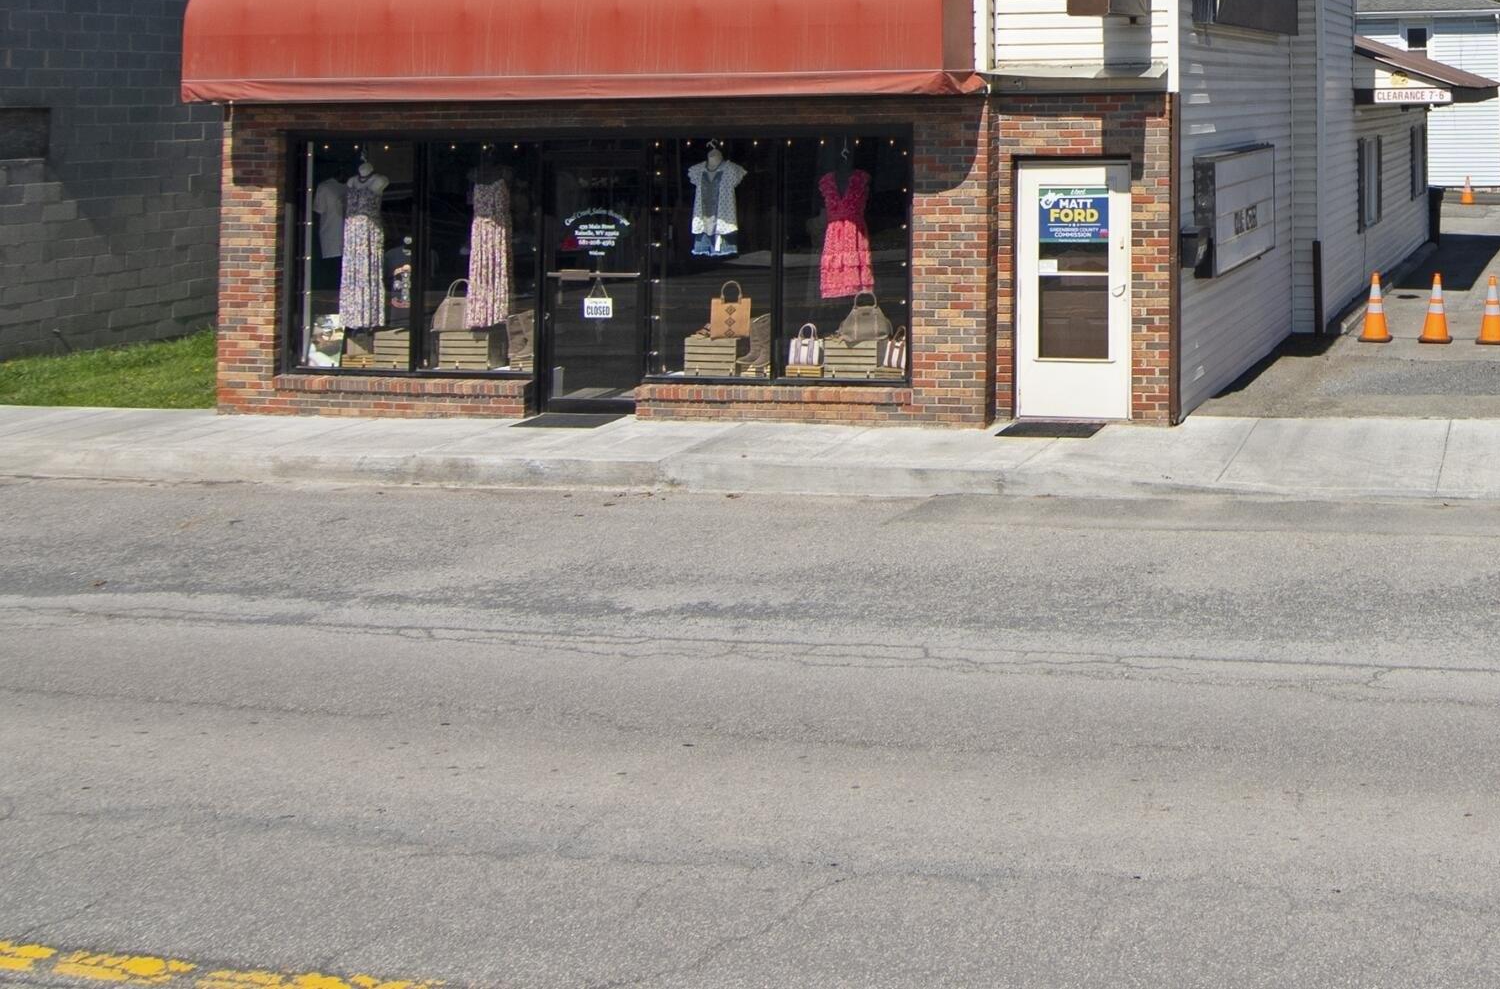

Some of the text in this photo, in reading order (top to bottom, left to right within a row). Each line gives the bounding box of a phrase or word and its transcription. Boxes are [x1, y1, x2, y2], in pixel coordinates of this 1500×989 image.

[1377, 91, 1425, 101] CLEARANCE
[1059, 198, 1093, 209] MATT
[1049, 208, 1099, 223] FORD
[586, 305, 611, 316] CLOSED
